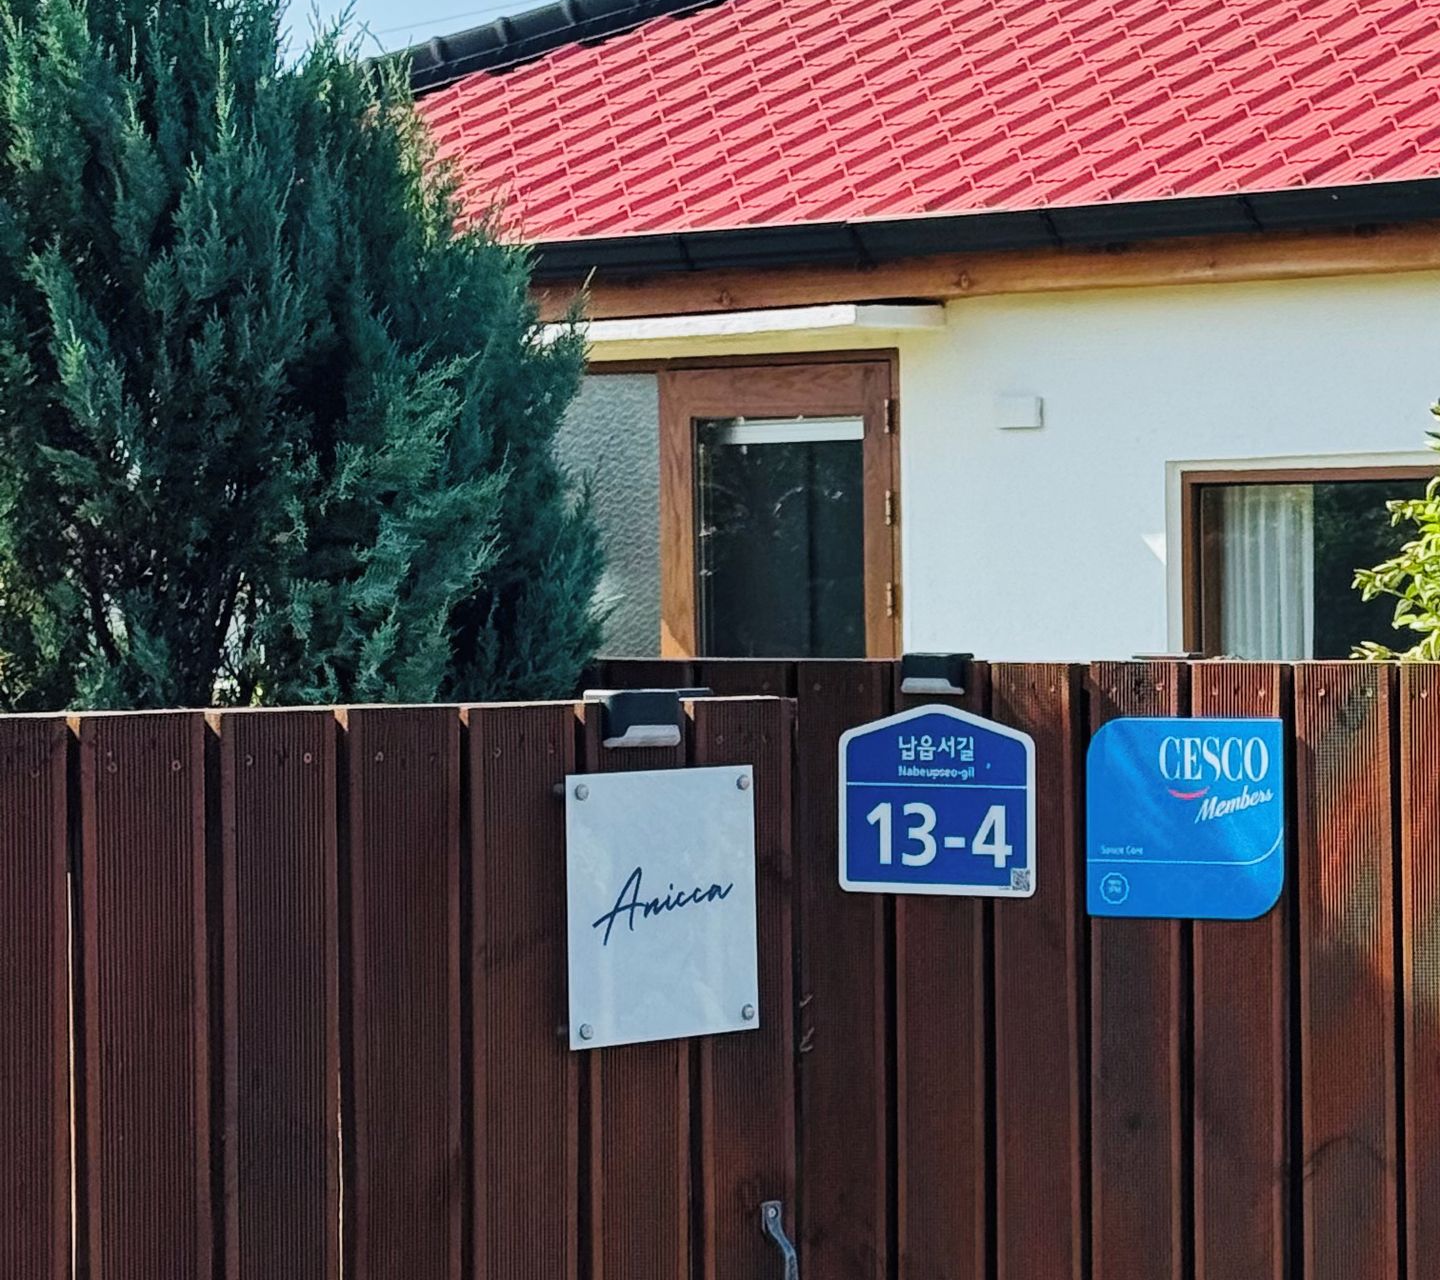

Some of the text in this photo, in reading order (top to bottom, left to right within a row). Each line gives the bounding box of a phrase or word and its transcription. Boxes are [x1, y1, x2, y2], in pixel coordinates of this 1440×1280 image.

[898, 734, 975, 762] 납읍서길
[1158, 736, 1270, 782] CESCO
[898, 765, 975, 781] Nabeupseo-gil
[1194, 785, 1274, 824] Members
[865, 802, 1013, 869] 13-4
